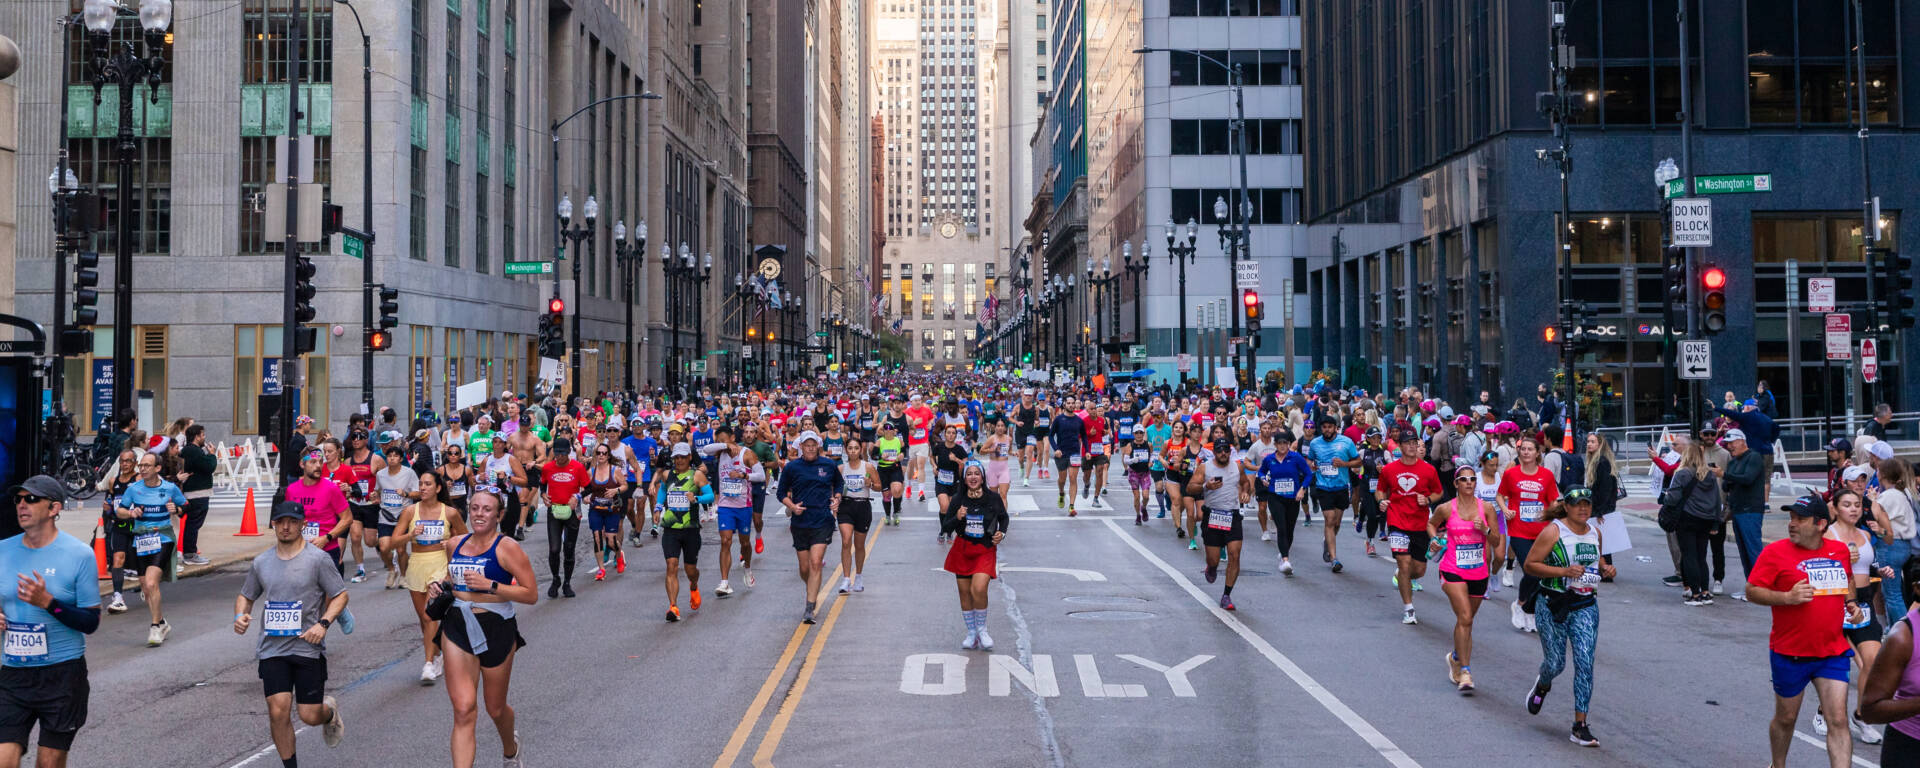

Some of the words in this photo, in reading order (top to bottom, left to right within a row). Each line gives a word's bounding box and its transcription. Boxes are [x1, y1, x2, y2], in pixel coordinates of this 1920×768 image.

[1704, 179, 1744, 191] Washington
[1675, 206, 1687, 216] DO
[1691, 205, 1708, 216] NOT
[1675, 221, 1709, 231] BLOCK
[1685, 344, 1707, 353] ONE
[1685, 355, 1707, 363] WAY
[1810, 569, 1846, 580] N67176
[266, 611, 299, 625] J39376
[6, 632, 43, 648] J41604
[900, 653, 1216, 697] ONLY
